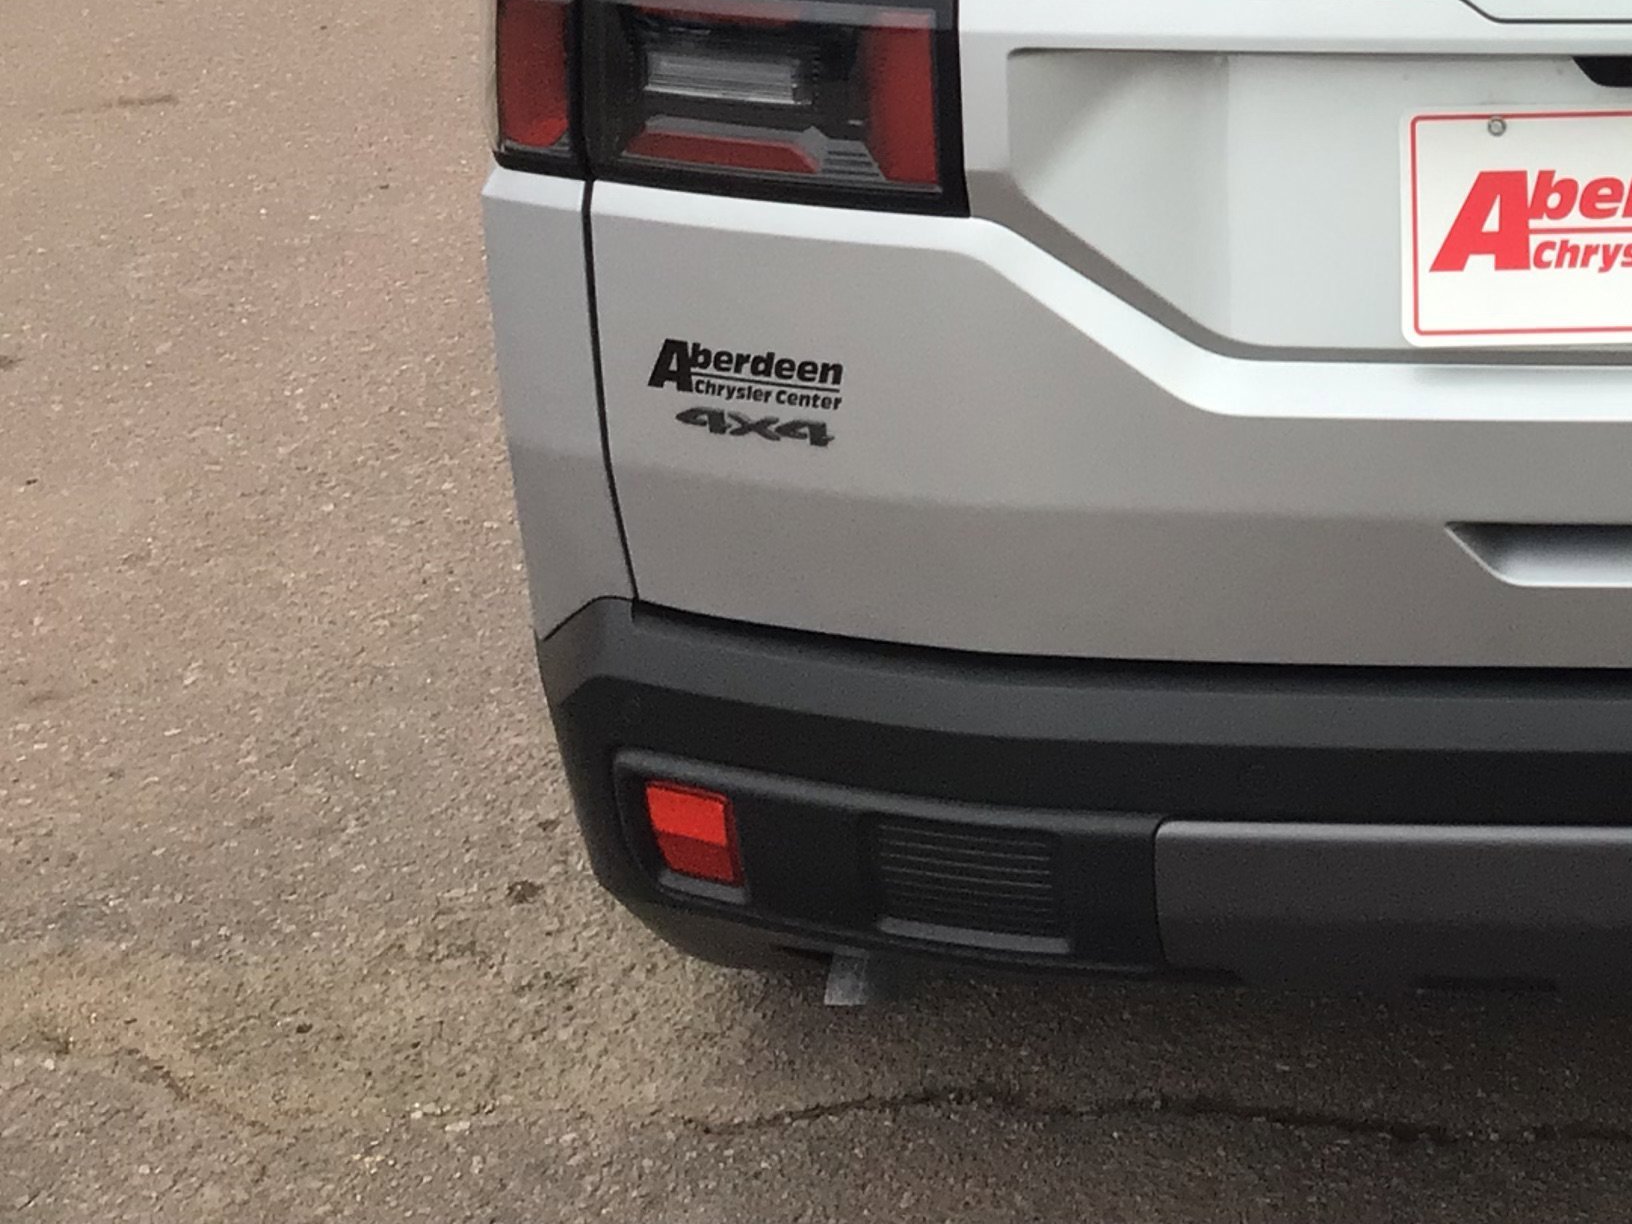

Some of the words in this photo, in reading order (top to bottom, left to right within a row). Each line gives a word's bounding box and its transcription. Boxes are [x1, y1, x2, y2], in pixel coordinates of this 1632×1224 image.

[647, 338, 844, 392] Aberdeen
[694, 379, 772, 401] Chrysler
[775, 389, 843, 410] Center
